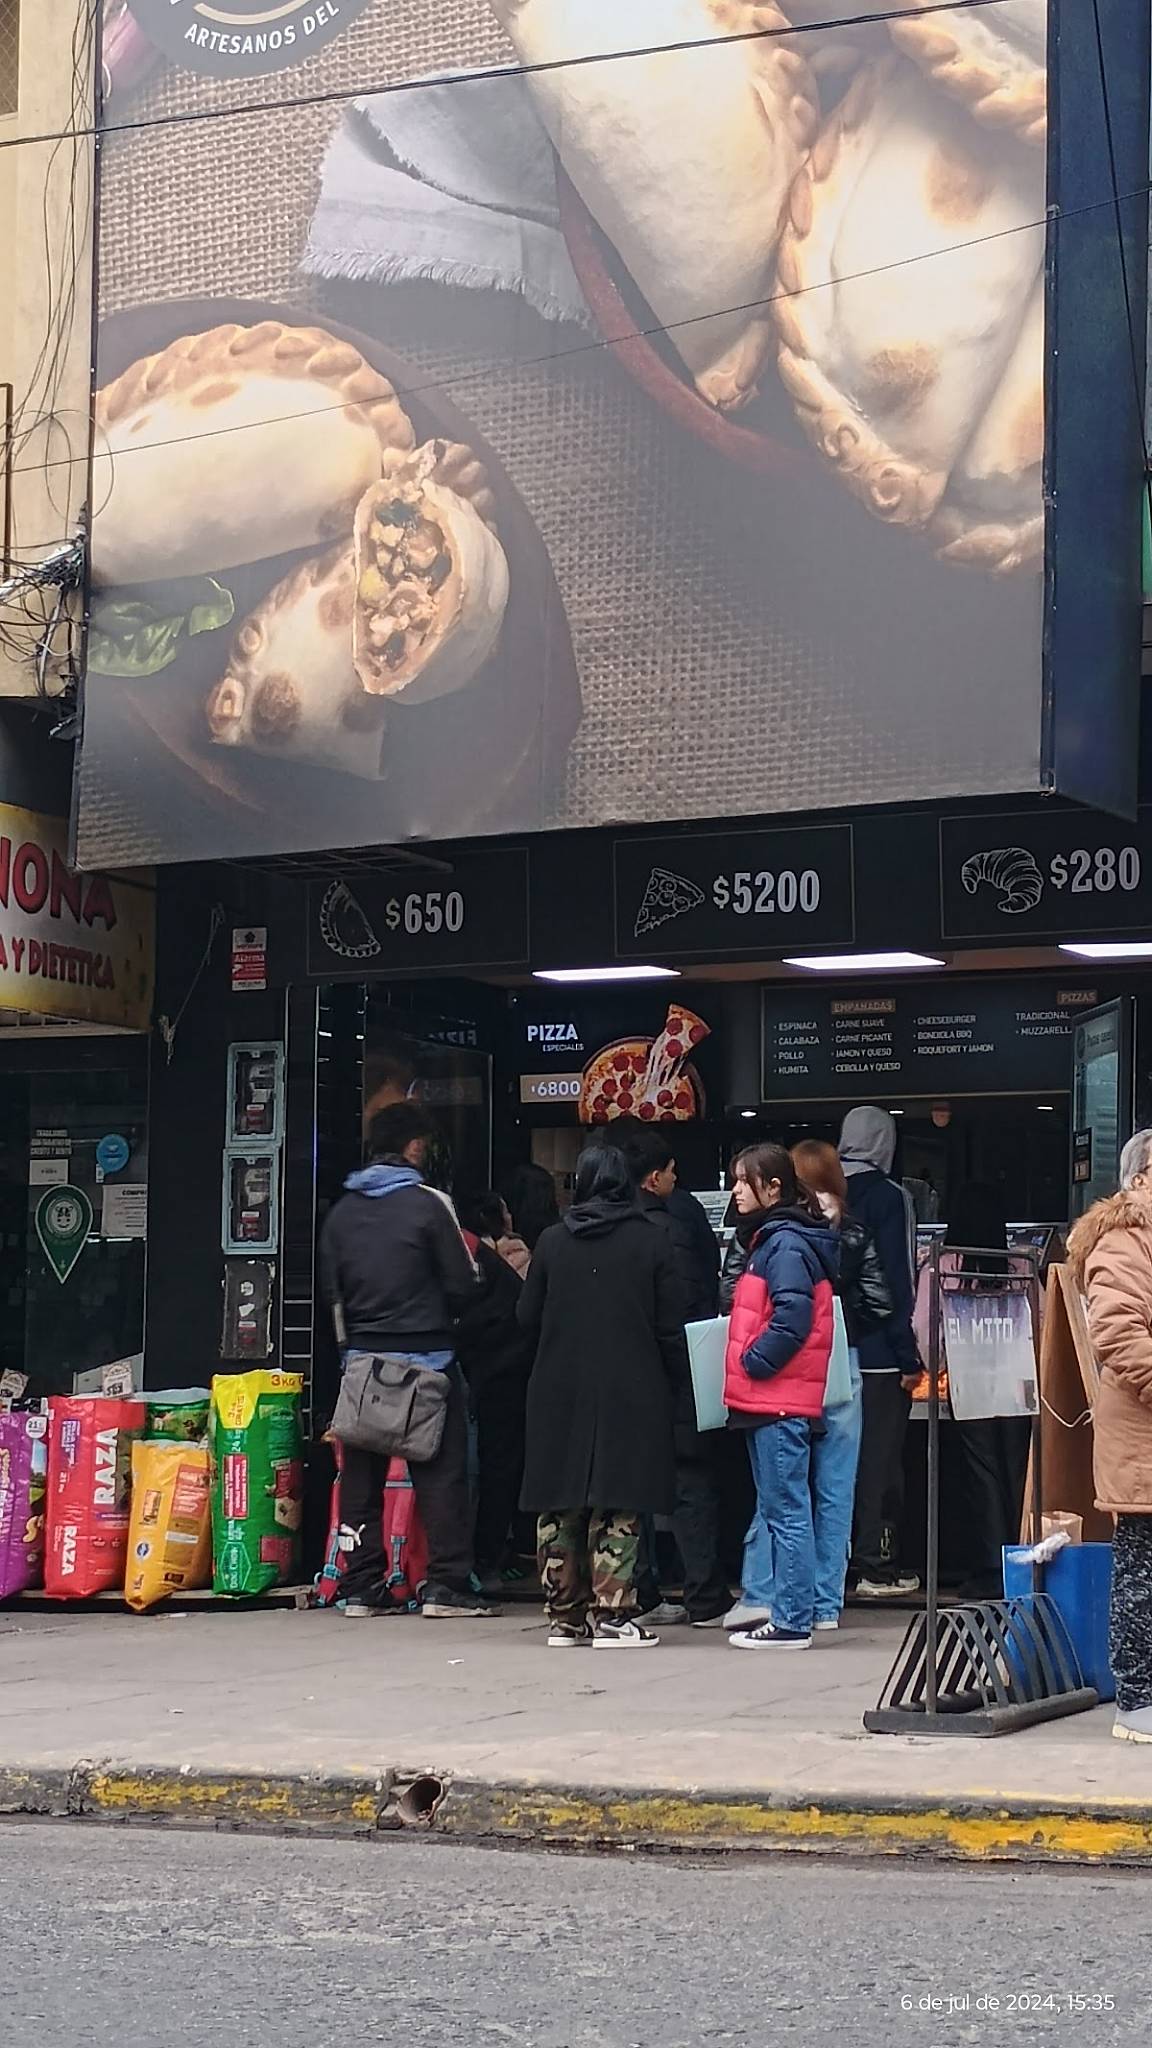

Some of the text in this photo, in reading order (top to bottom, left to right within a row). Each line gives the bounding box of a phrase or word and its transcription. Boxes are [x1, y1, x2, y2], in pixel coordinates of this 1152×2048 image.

[184, 1, 340, 54] ARTESANOS DEL
[1050, 846, 1142, 893] $280
[712, 870, 821, 914] $5200
[385, 891, 464, 934] $650
[12, 936, 25, 973] Y
[28, 938, 115, 989] DIETETICA
[1061, 992, 1096, 1002] PIZZAS
[528, 1024, 578, 1041] PIZZA
[778, 1021, 817, 1031] ESPINACA
[1021, 1026, 1072, 1035] MUZZARELL
[778, 1036, 820, 1045] CALABAZA
[778, 1051, 804, 1060] POLLO
[948, 1318, 1013, 1344] EL MITO
[232, 1441, 240, 1452] 24
[93, 1427, 118, 1504] RAZA
[61, 1525, 77, 1576] RAZA
[230, 1546, 239, 1570] CHOW
[230, 1571, 238, 1589] DOG
